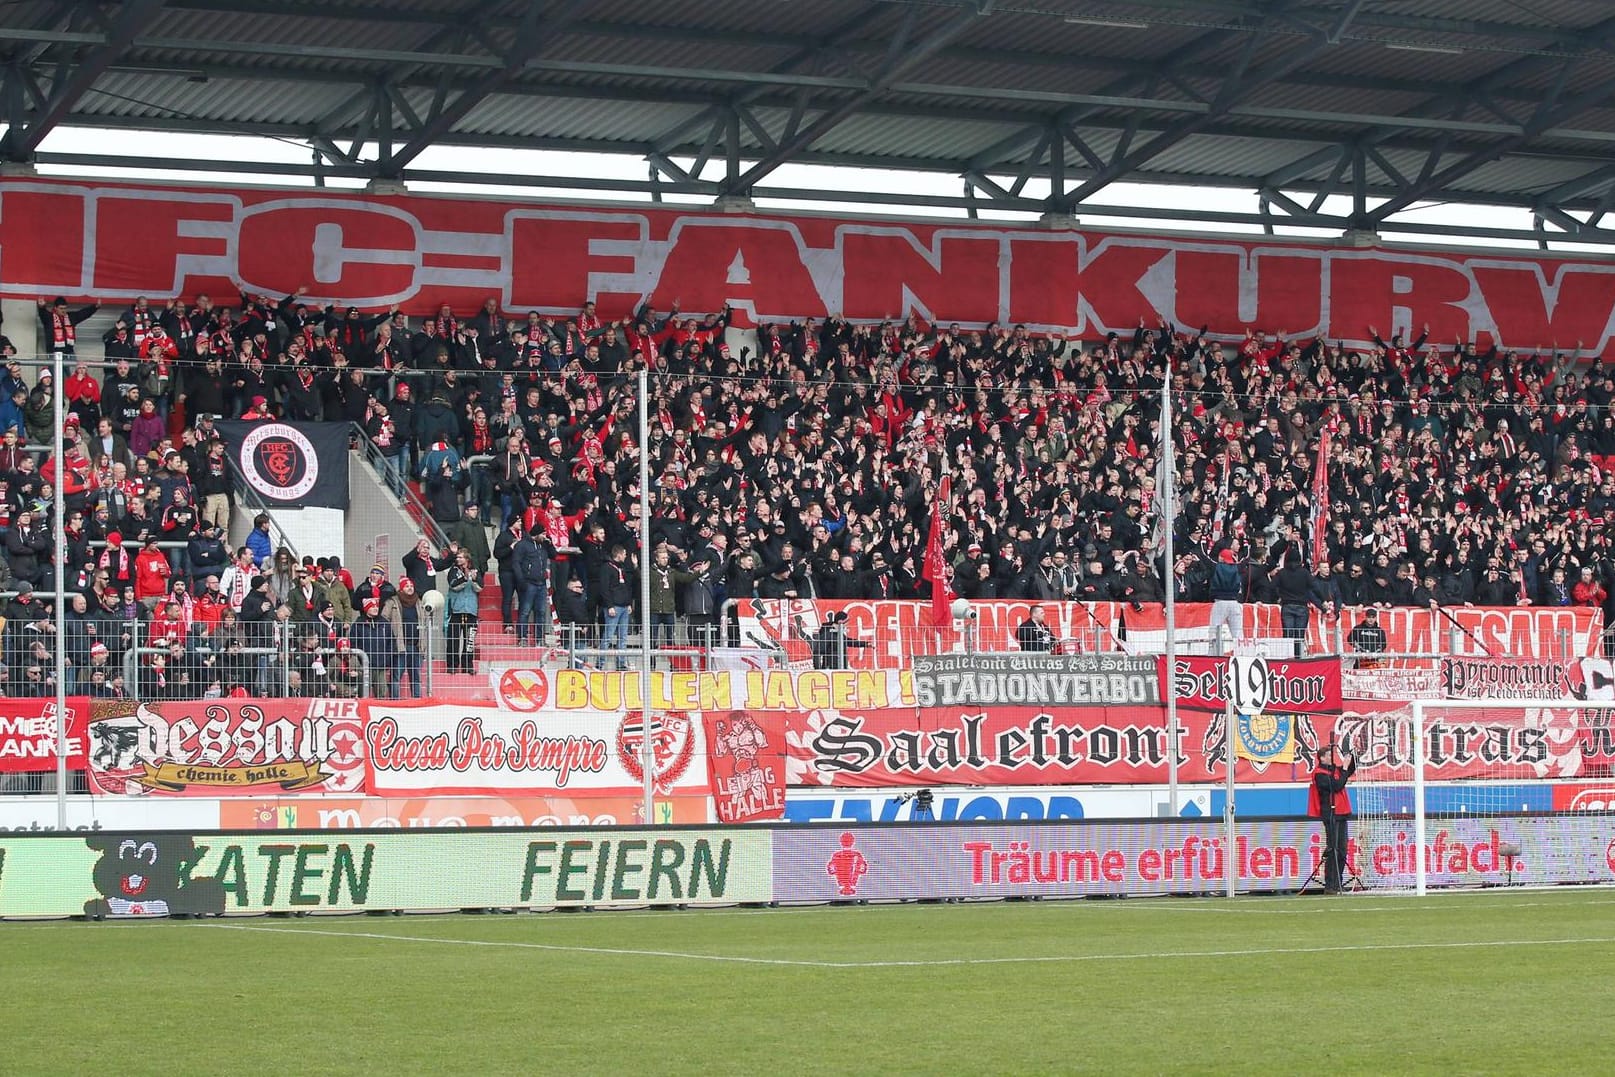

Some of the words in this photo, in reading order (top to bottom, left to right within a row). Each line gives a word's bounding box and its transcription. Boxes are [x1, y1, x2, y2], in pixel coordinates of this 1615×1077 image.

[266, 443, 289, 452] HFC
[554, 669, 732, 711] BULLEN
[744, 670, 888, 710] JAGEN
[1443, 659, 1563, 696] Pyromanie
[1467, 687, 1482, 698] ist
[1487, 684, 1563, 700] Leidenschaft
[367, 716, 449, 771] Coesa
[452, 717, 506, 772] Per
[507, 719, 608, 787] Sempre
[177, 767, 236, 783] chemie
[246, 767, 289, 782] halle
[720, 788, 785, 821] HALLE
[520, 838, 732, 902] FEIERN
[962, 841, 1126, 886] Träume
